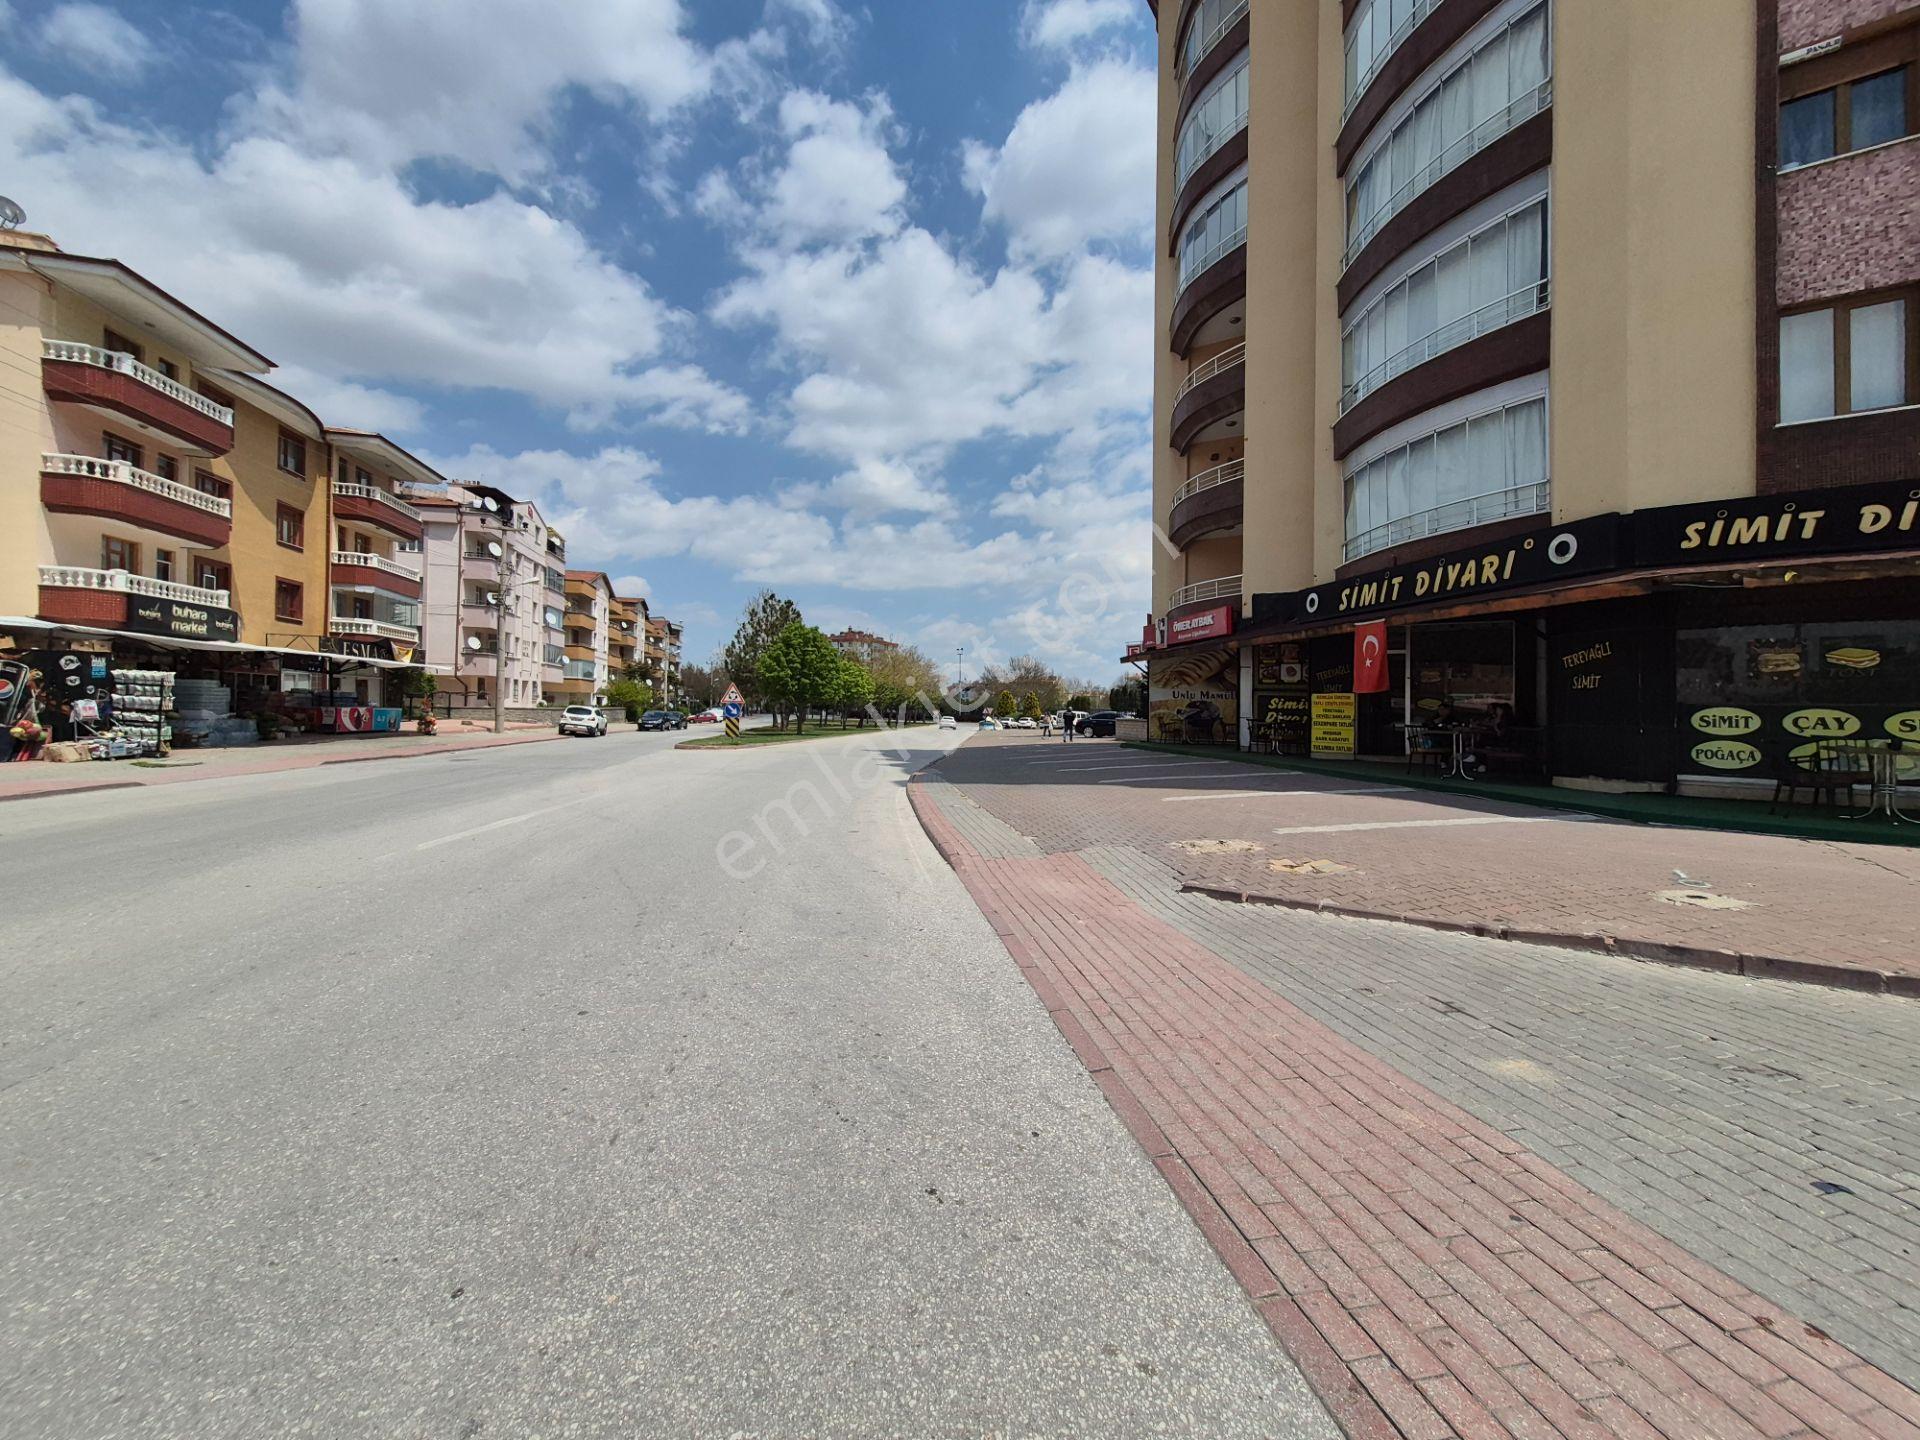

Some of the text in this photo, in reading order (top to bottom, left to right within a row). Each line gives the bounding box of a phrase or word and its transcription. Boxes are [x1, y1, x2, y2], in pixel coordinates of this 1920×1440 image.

[1680, 502, 1826, 549] SİMİT
[1338, 550, 1516, 612] SİMİT DİYARI
[172, 604, 208, 621] buhara
[171, 620, 208, 635] market
[1562, 641, 1612, 669] TEREYAĞLI
[1792, 716, 1851, 733] ÇAY
[1899, 719, 1920, 733] S
[1695, 746, 1757, 764] POĞAÇA
